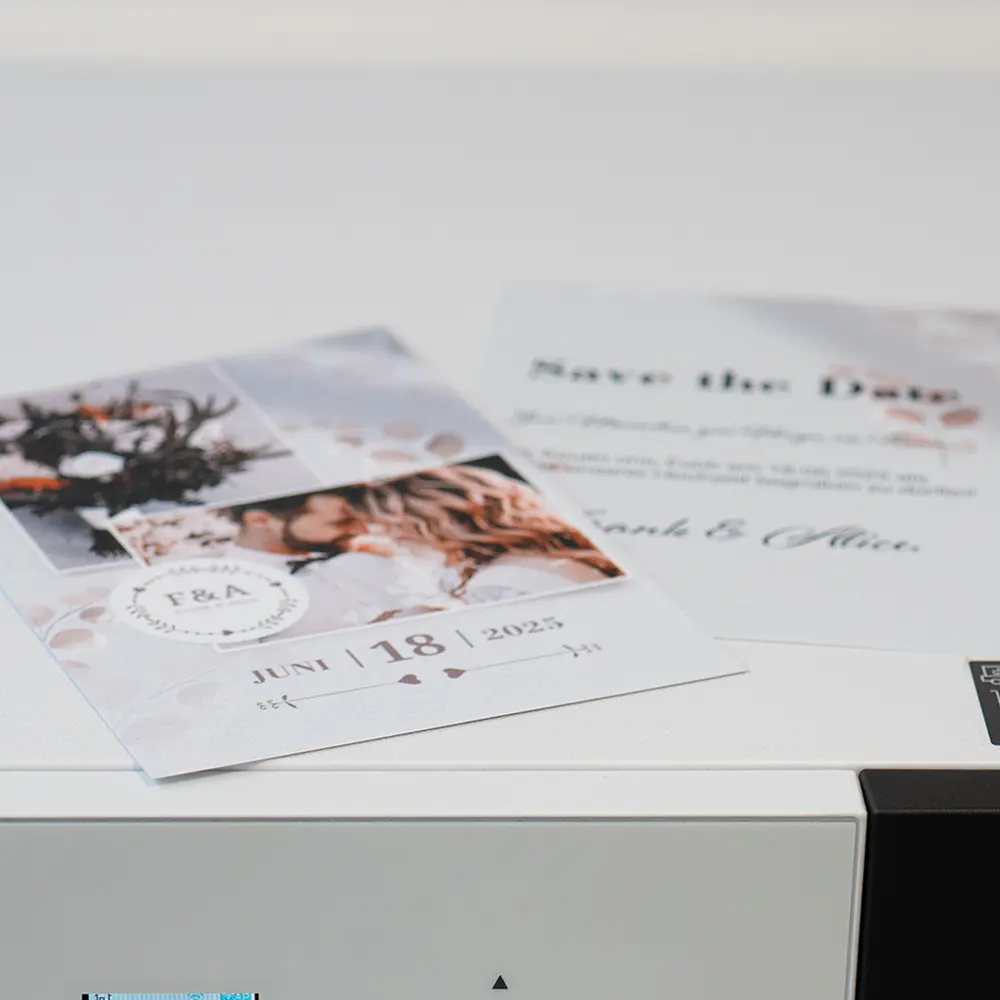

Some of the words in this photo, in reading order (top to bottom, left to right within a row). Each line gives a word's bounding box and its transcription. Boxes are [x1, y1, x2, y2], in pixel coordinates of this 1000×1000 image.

[527, 357, 673, 386] Save
[697, 367, 791, 394] the
[819, 375, 963, 404] Date
[165, 584, 251, 606] F&A
[251, 658, 331, 685] JUNI
[370, 633, 446, 664] 18
[481, 616, 565, 642] 2025
